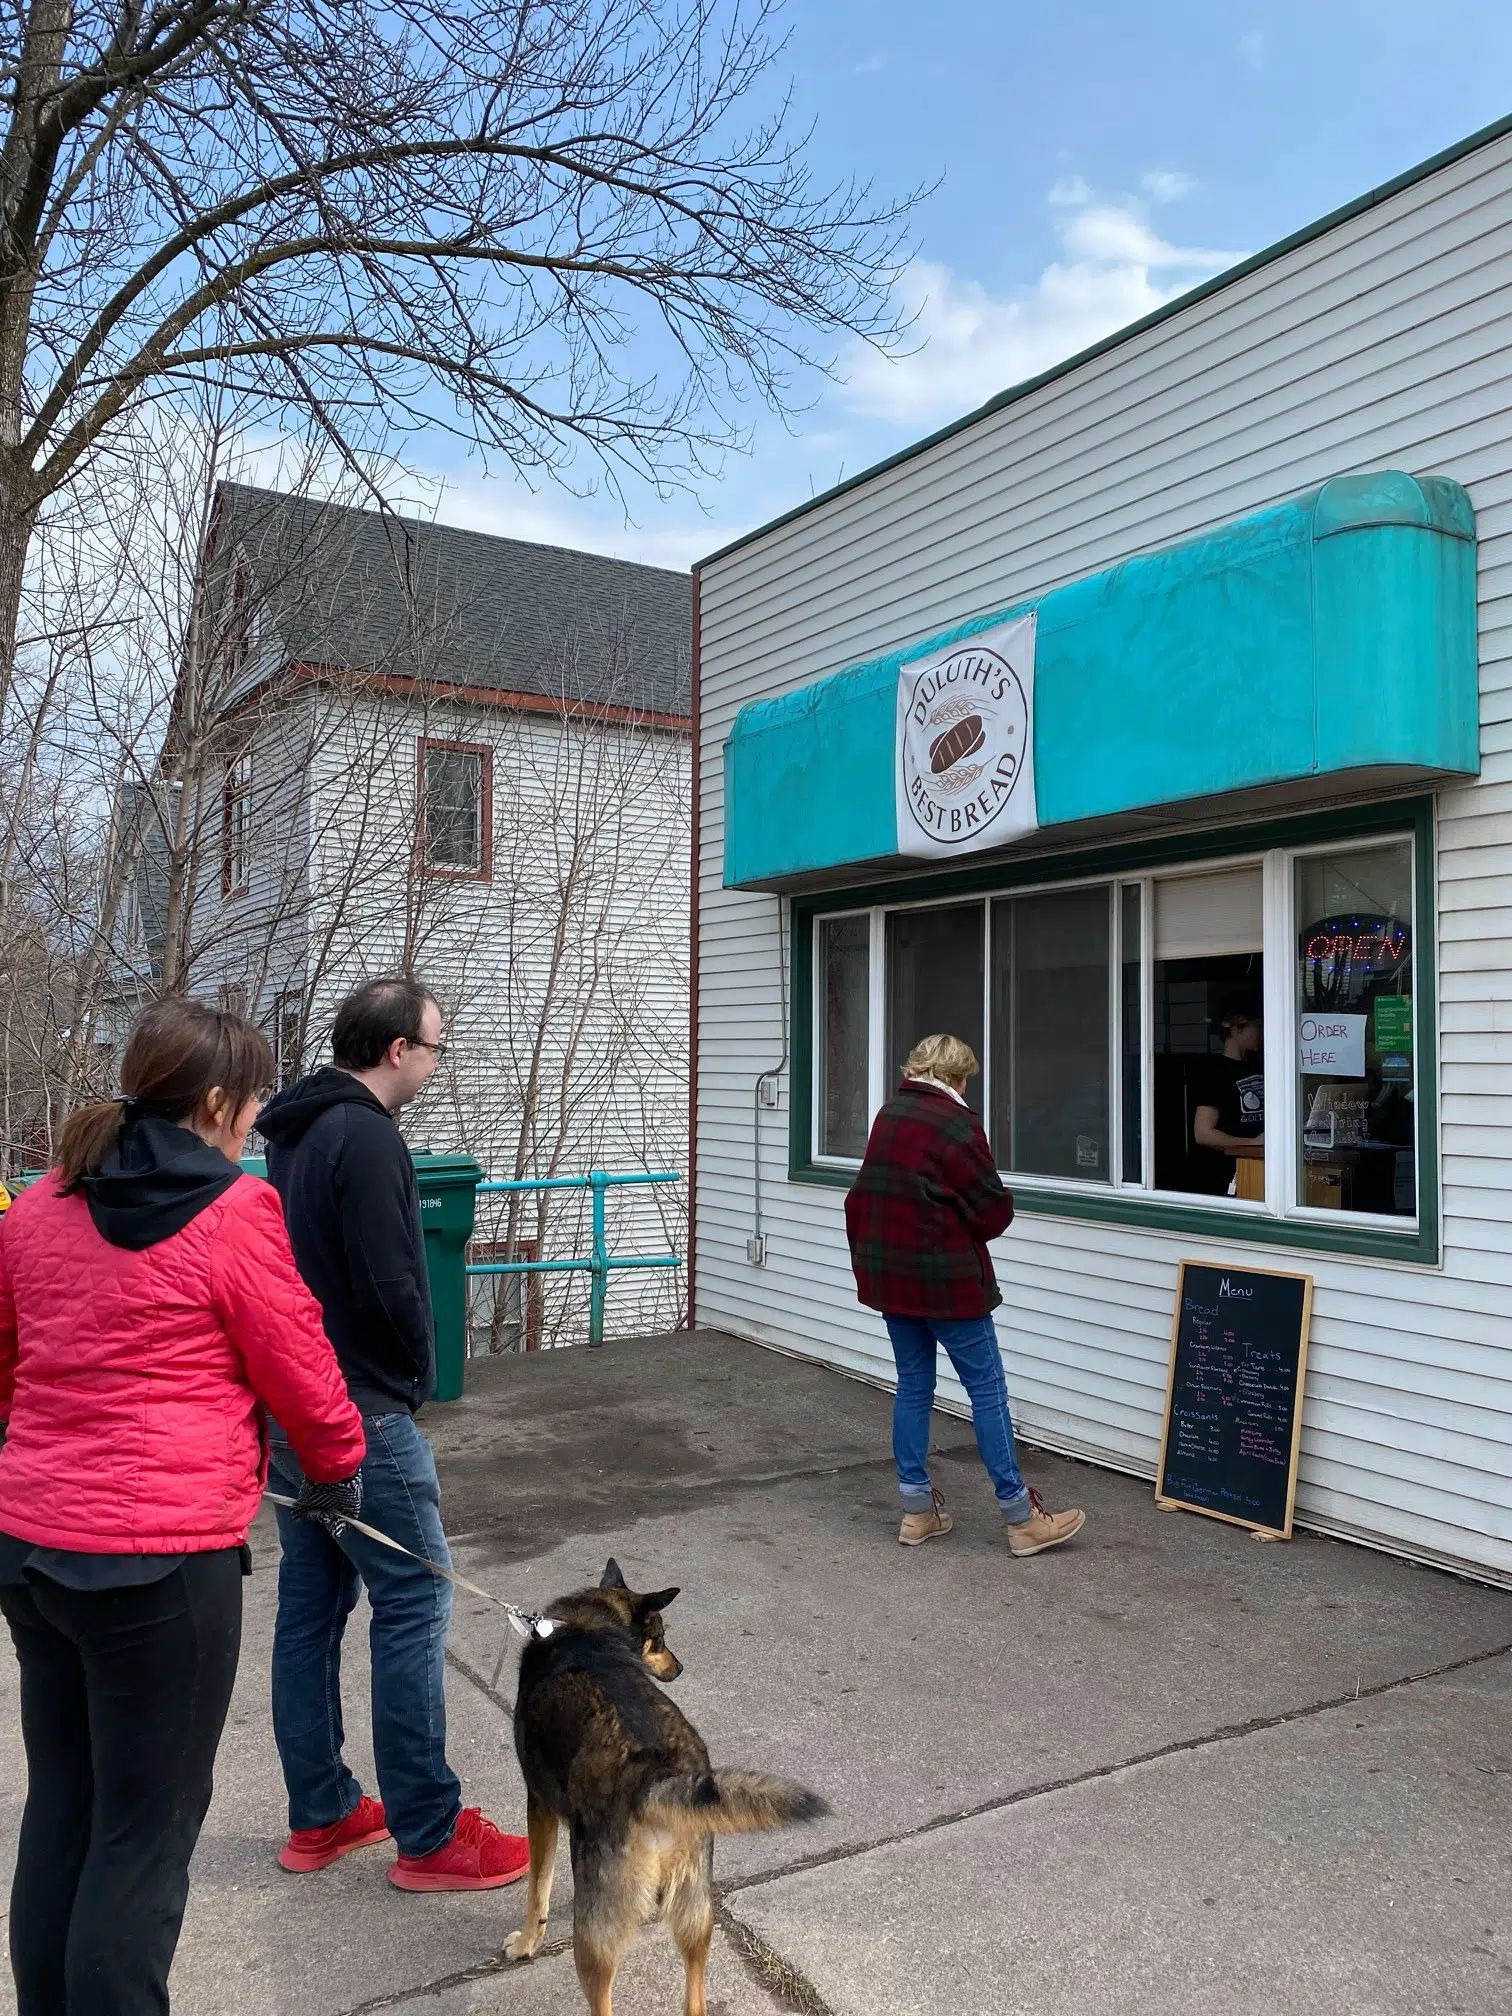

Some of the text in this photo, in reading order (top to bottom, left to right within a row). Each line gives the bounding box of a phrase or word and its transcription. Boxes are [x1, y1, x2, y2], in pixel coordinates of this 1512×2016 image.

[913, 657, 1011, 726] DULUTH'S
[911, 753, 1016, 833] BEST BREAD
[1306, 935, 1406, 960] OPEN
[1307, 1092, 1369, 1112] Window
[1219, 1277, 1253, 1297] Menu
[1185, 1298, 1219, 1316] Bread
[1241, 1342, 1281, 1360] Treats
[1173, 1404, 1219, 1421] Croissants
